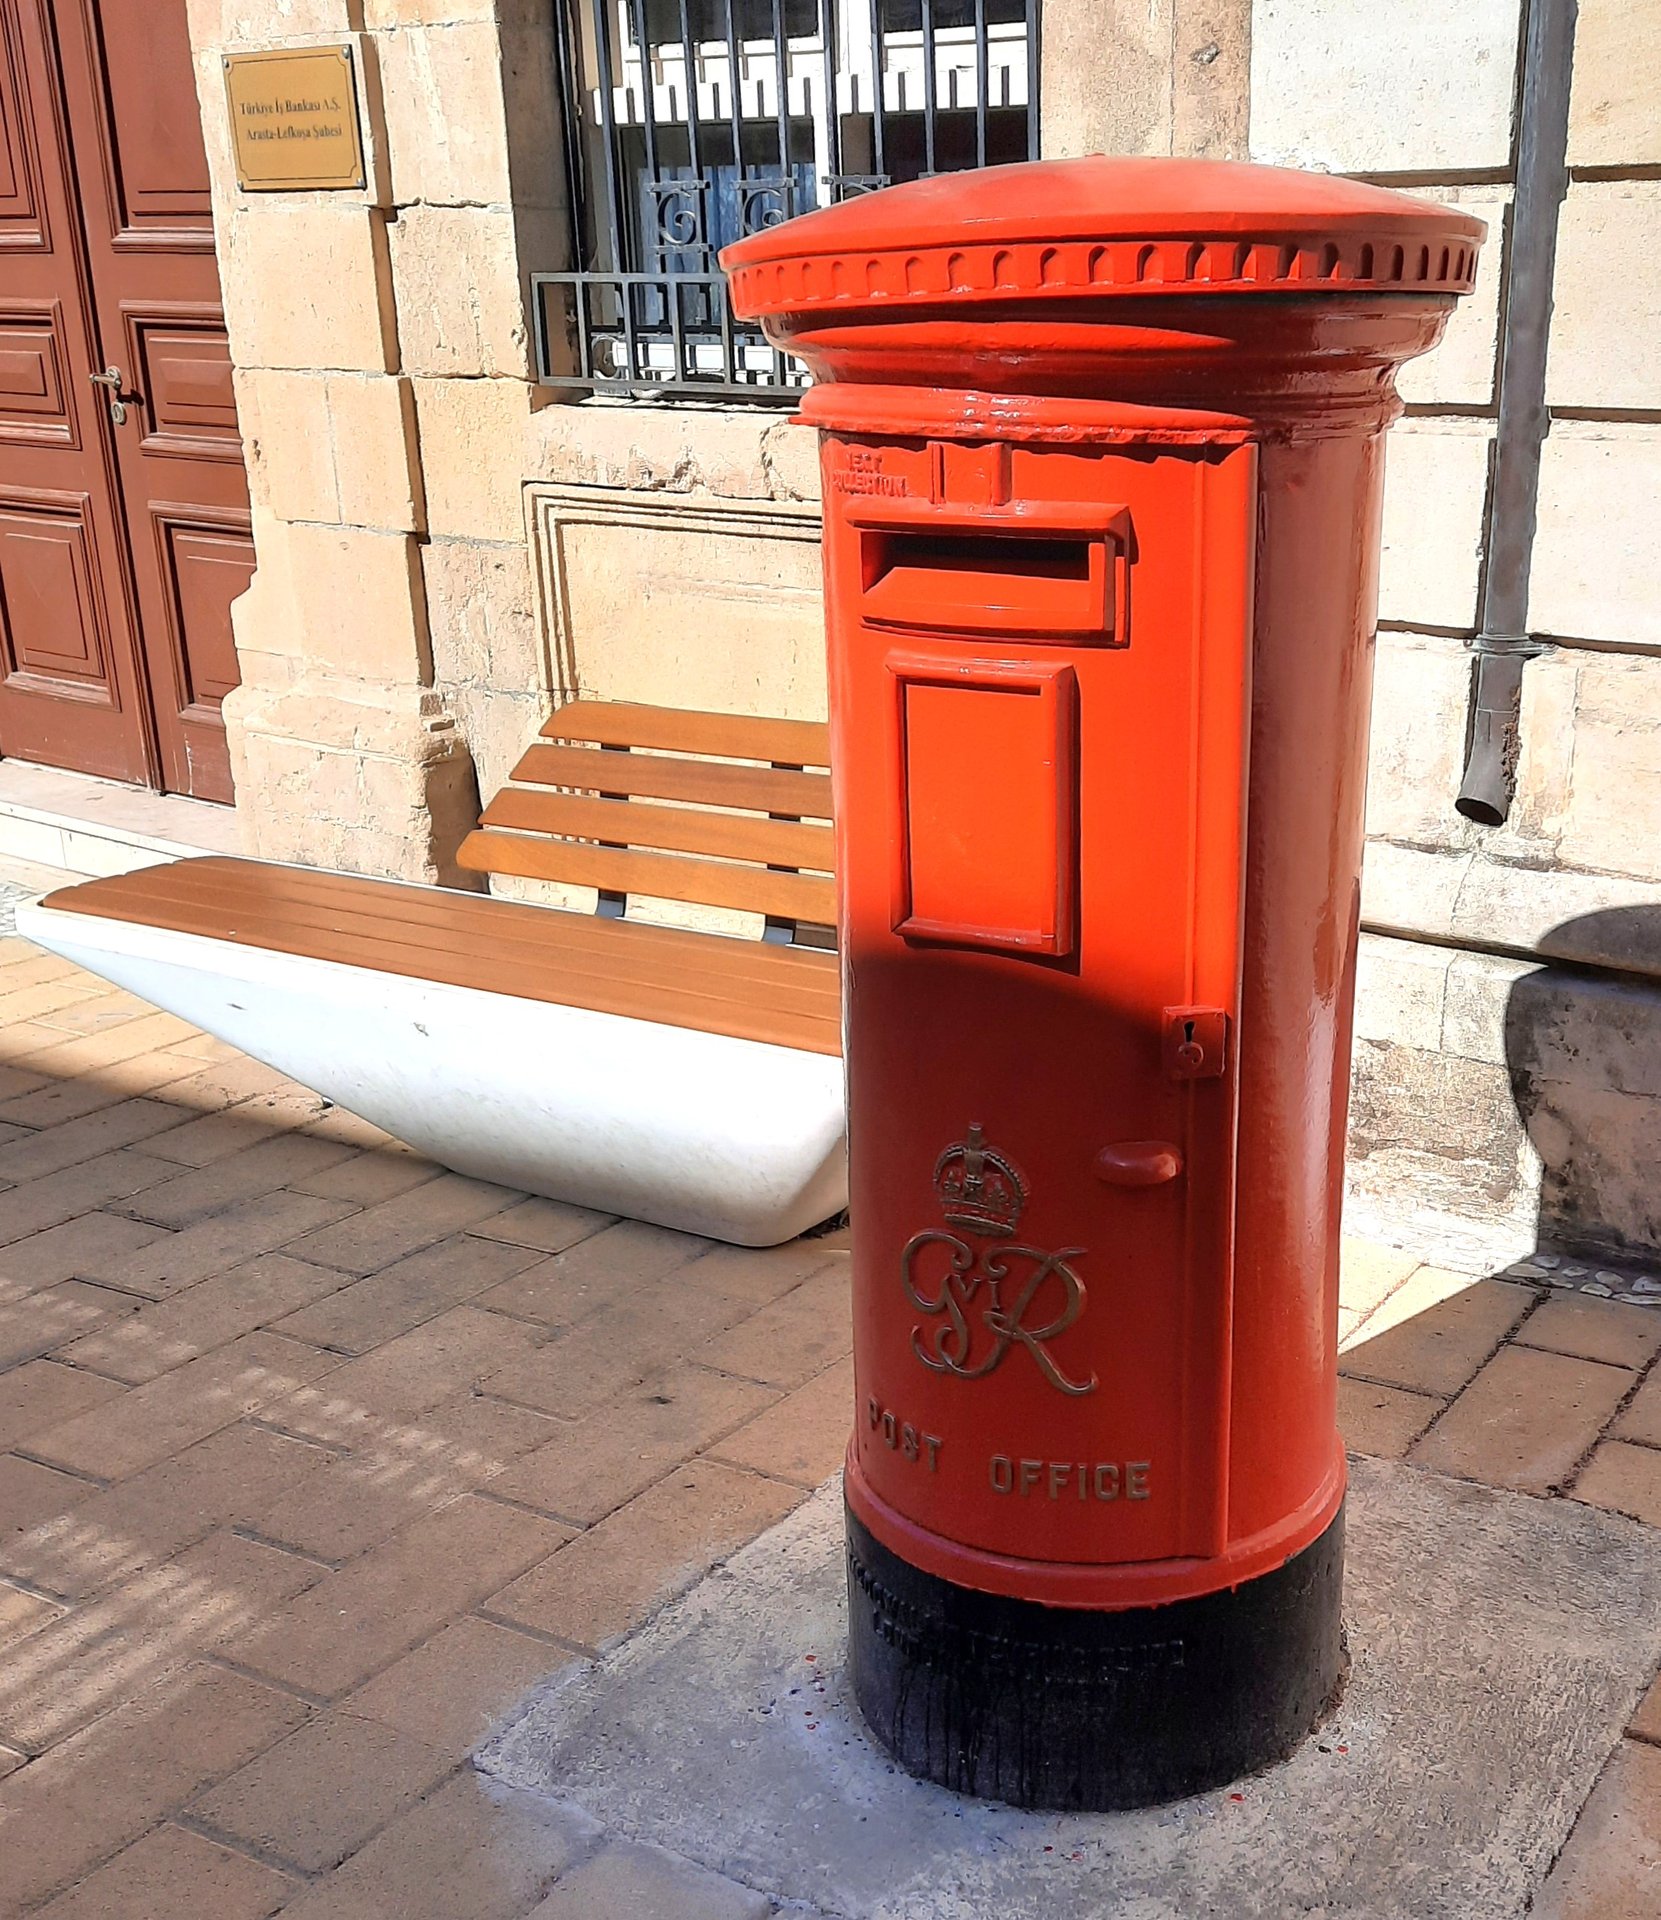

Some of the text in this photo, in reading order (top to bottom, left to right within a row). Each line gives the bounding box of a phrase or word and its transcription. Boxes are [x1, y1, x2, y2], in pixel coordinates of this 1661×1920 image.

[239, 102, 274, 117] Türkiye
[285, 99, 321, 113] Bankası
[312, 123, 342, 140] Şubesi
[868, 1396, 1152, 1501] POST OFFICE
